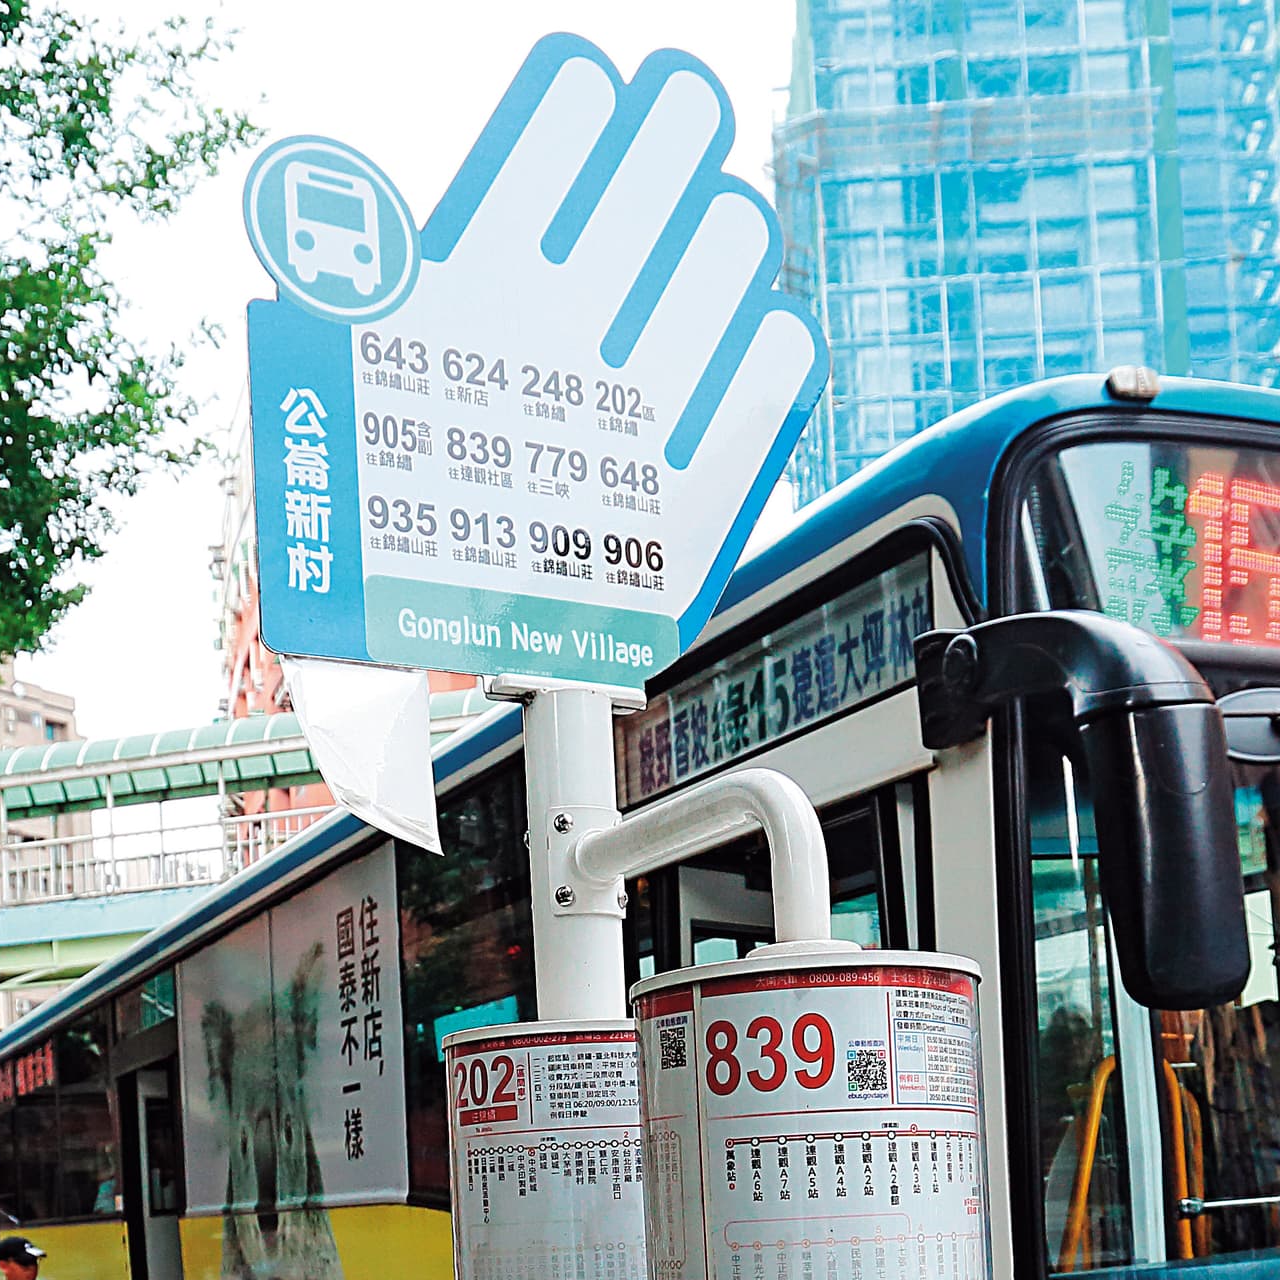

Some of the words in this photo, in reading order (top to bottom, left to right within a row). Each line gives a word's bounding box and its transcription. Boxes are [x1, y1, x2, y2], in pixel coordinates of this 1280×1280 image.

[360, 331, 429, 374] 643
[442, 348, 509, 391] 624
[522, 364, 584, 406] 248
[362, 371, 431, 396] 往錦繡山莊
[444, 388, 489, 407] 往新店
[523, 402, 566, 423] 往錦繡
[598, 417, 639, 437] 往錦繡
[280, 387, 333, 594] 公崙新村
[363, 411, 418, 452] 905
[447, 427, 512, 469] 839
[525, 441, 588, 483] 779
[600, 456, 660, 496] 648
[366, 449, 413, 472] 往錦繡
[448, 464, 514, 489] 往達觀社區
[527, 478, 570, 500] 往三峽
[601, 493, 661, 515] 往錦繡山莊
[367, 495, 437, 537] 935
[450, 508, 517, 549] 913
[529, 521, 592, 560] 909
[603, 533, 664, 572] 906
[369, 533, 439, 558] 往錦繡山莊
[452, 546, 518, 569] 往錦繡山莊
[531, 557, 593, 580] 往錦繡山莊
[606, 568, 664, 591] 往錦繡山莊
[398, 607, 501, 648] Gonglun
[511, 622, 563, 653] New
[571, 630, 654, 666] Village
[336, 906, 364, 1161] 國泰不一樣
[705, 1012, 835, 1096] 839
[454, 1055, 516, 1109] 202
